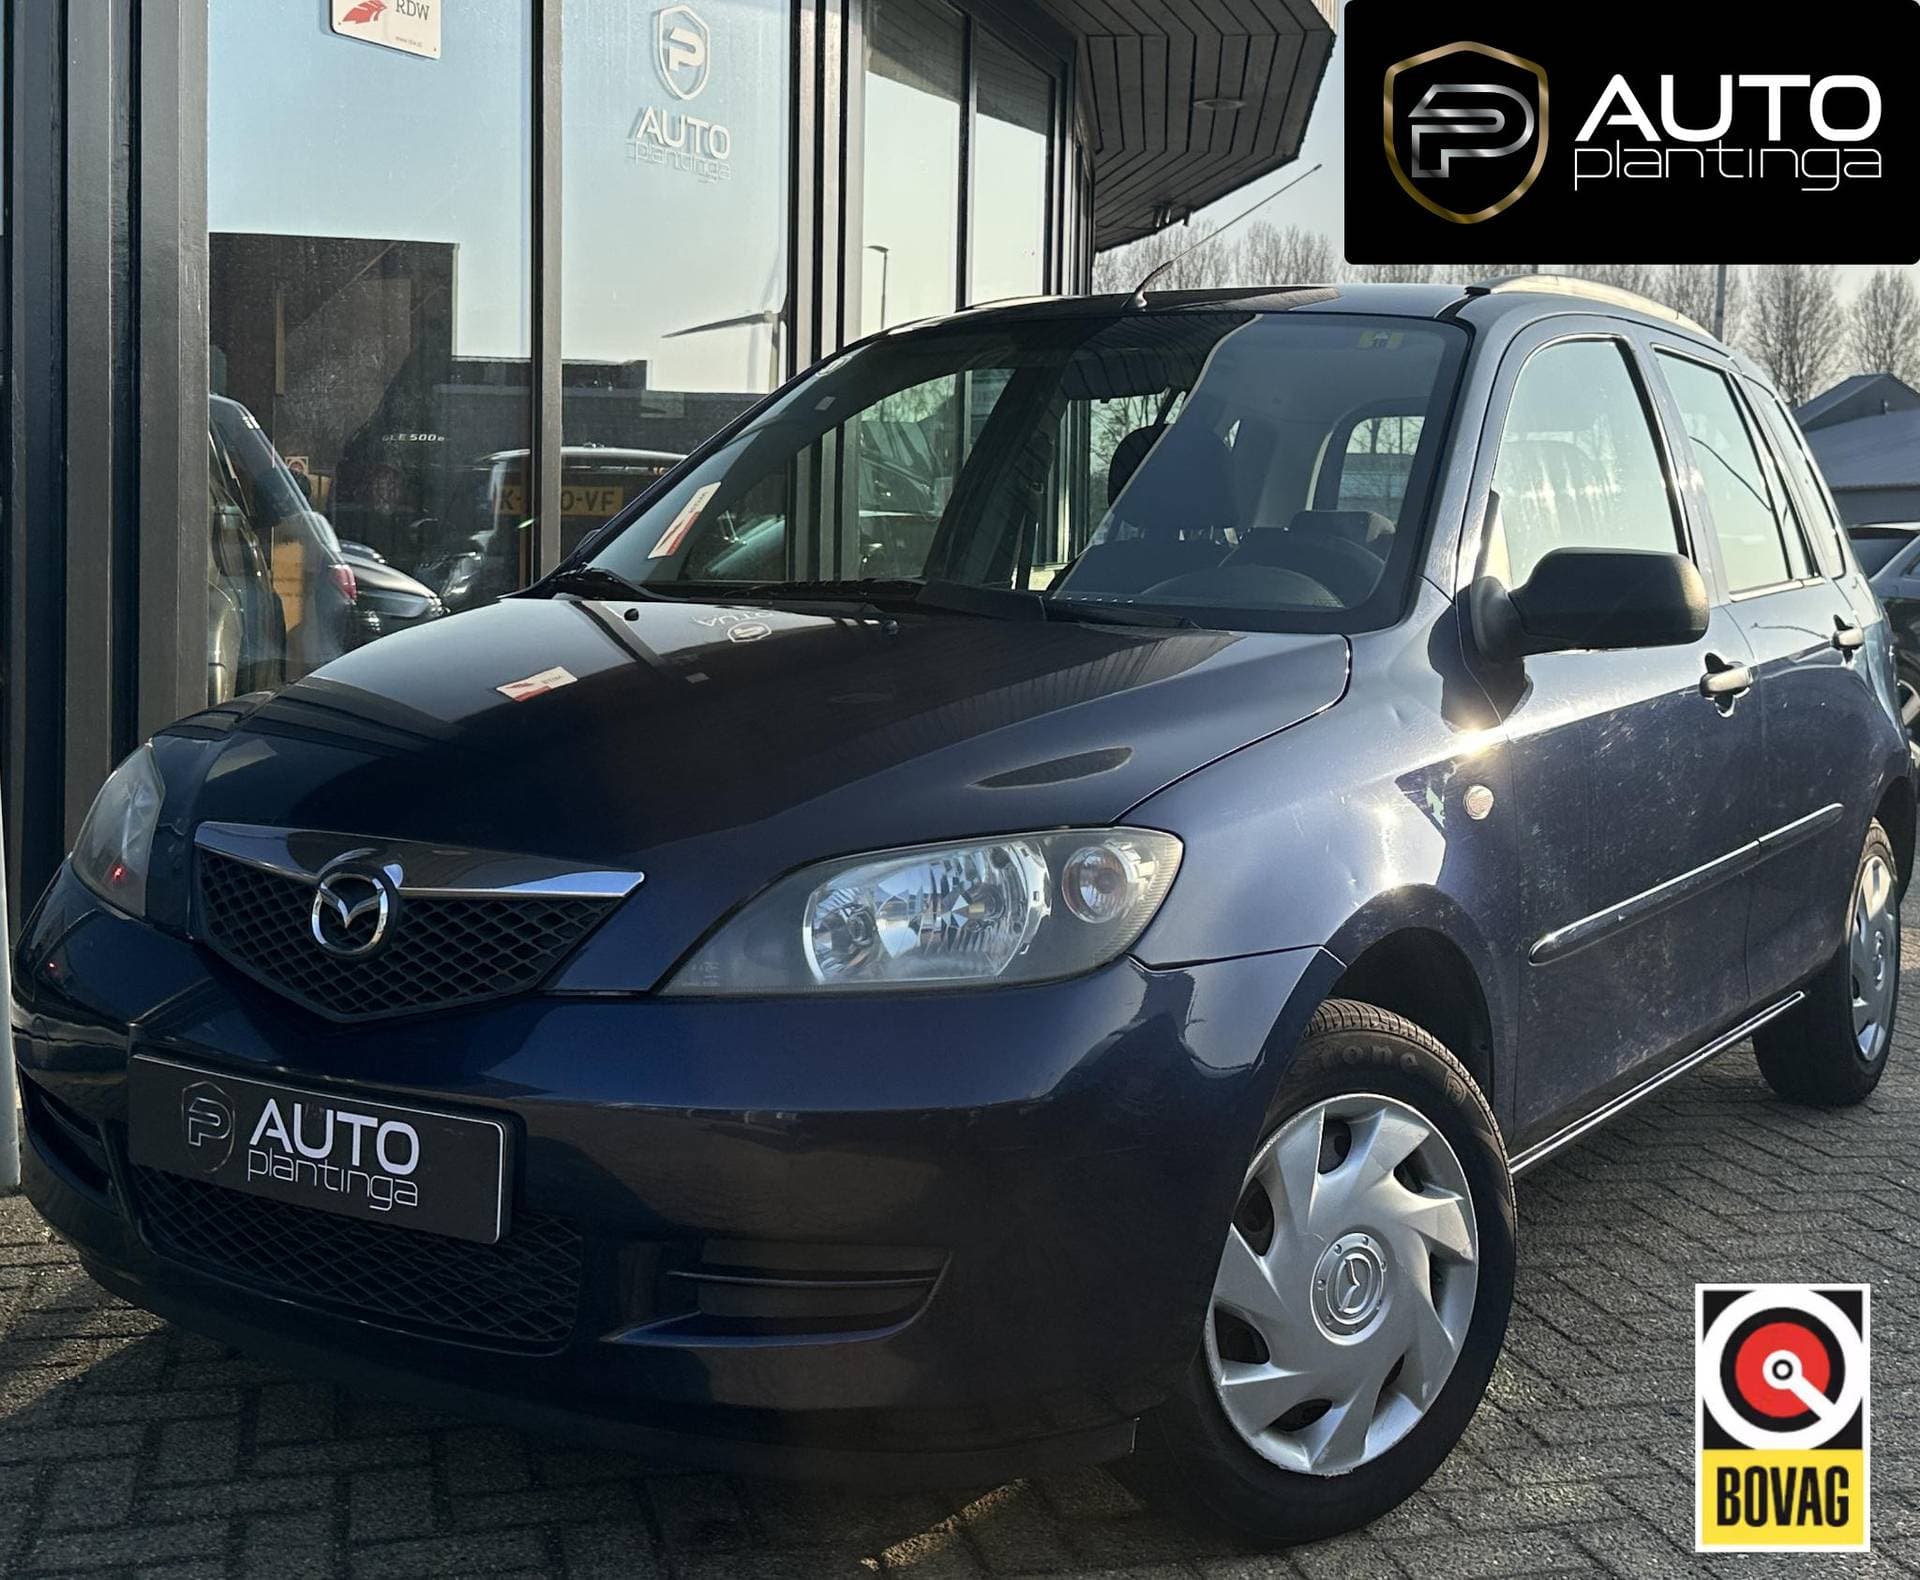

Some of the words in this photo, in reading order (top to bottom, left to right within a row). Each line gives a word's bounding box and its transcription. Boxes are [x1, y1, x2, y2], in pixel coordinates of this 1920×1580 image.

[396, 0, 430, 21] RDW
[636, 105, 731, 160] AUTO
[249, 1098, 420, 1176] AUTO
[247, 1148, 419, 1212] plantinga
